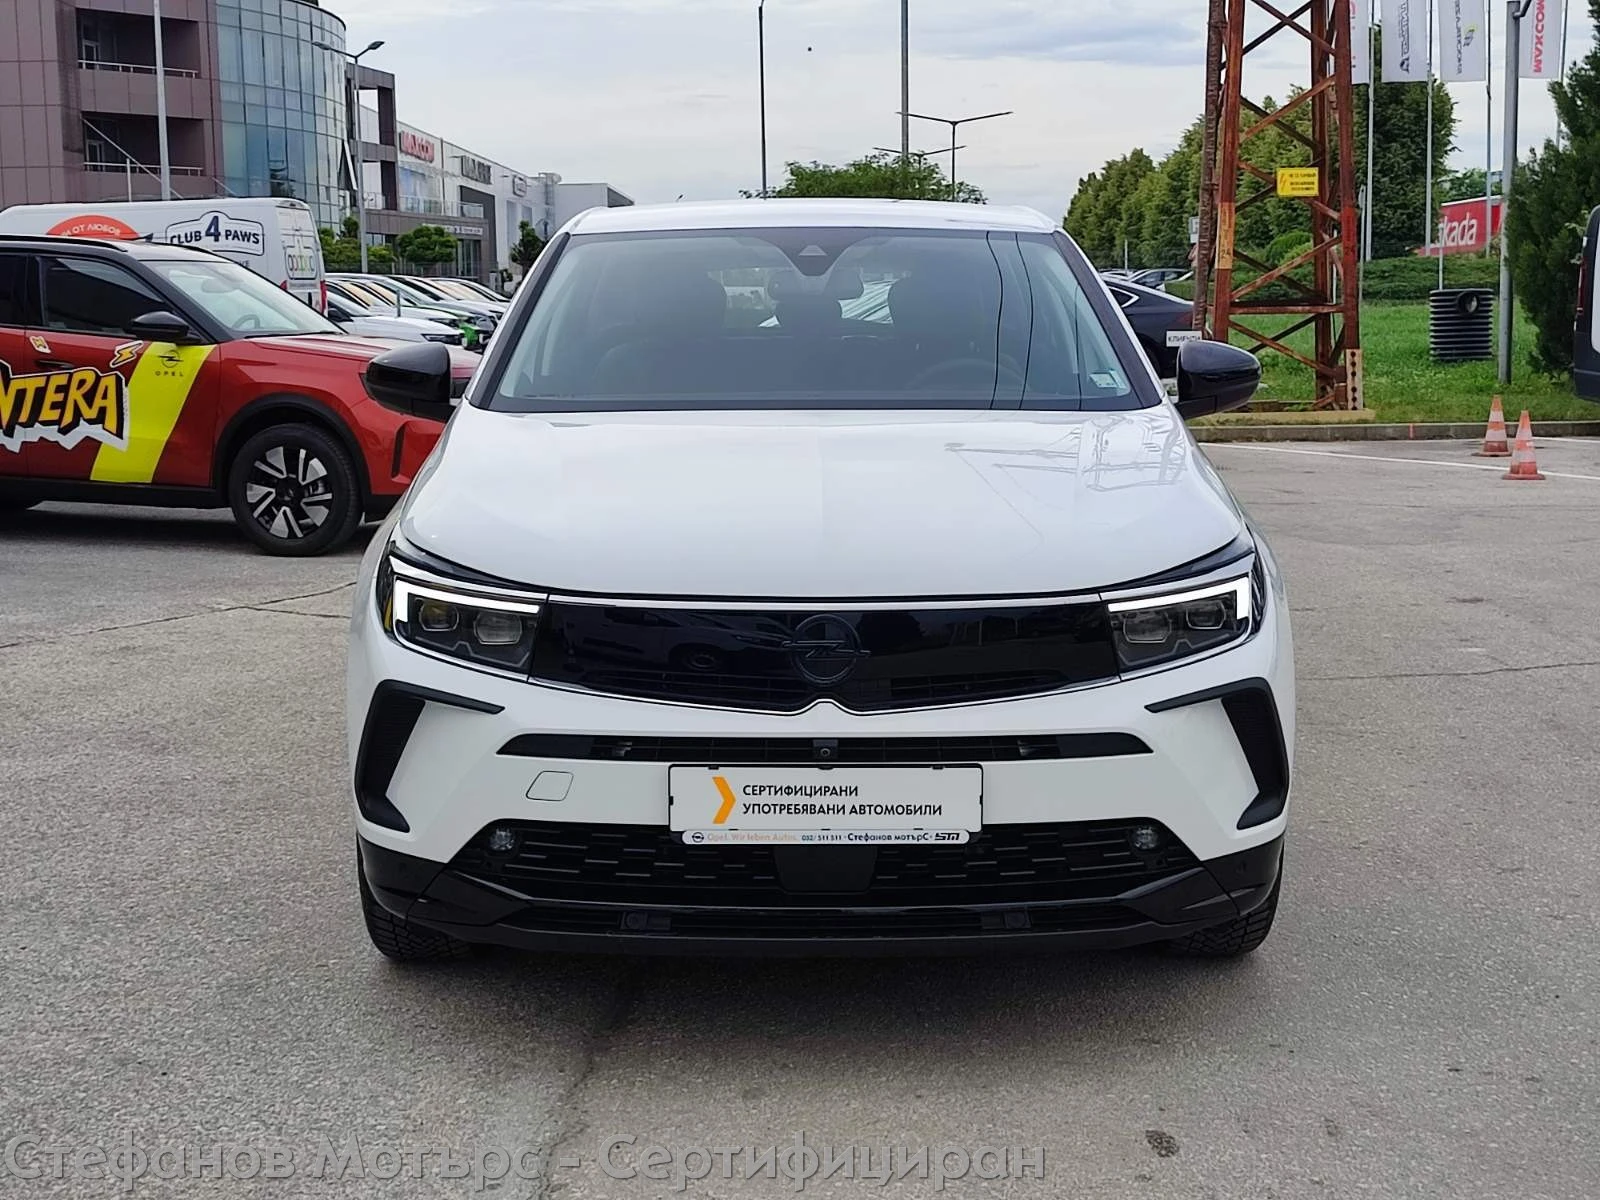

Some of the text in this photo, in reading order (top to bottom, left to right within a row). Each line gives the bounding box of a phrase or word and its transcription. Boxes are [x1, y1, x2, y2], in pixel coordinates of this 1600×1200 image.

[170, 215, 260, 244] CLUB 4 PAWS
[742, 784, 859, 798] СЕРТИФИЦИРАНИ
[742, 803, 942, 817] УПОТРЕБЯВАНИ АВТОМОБИЛИ
[847, 832, 892, 842] Стефанов
